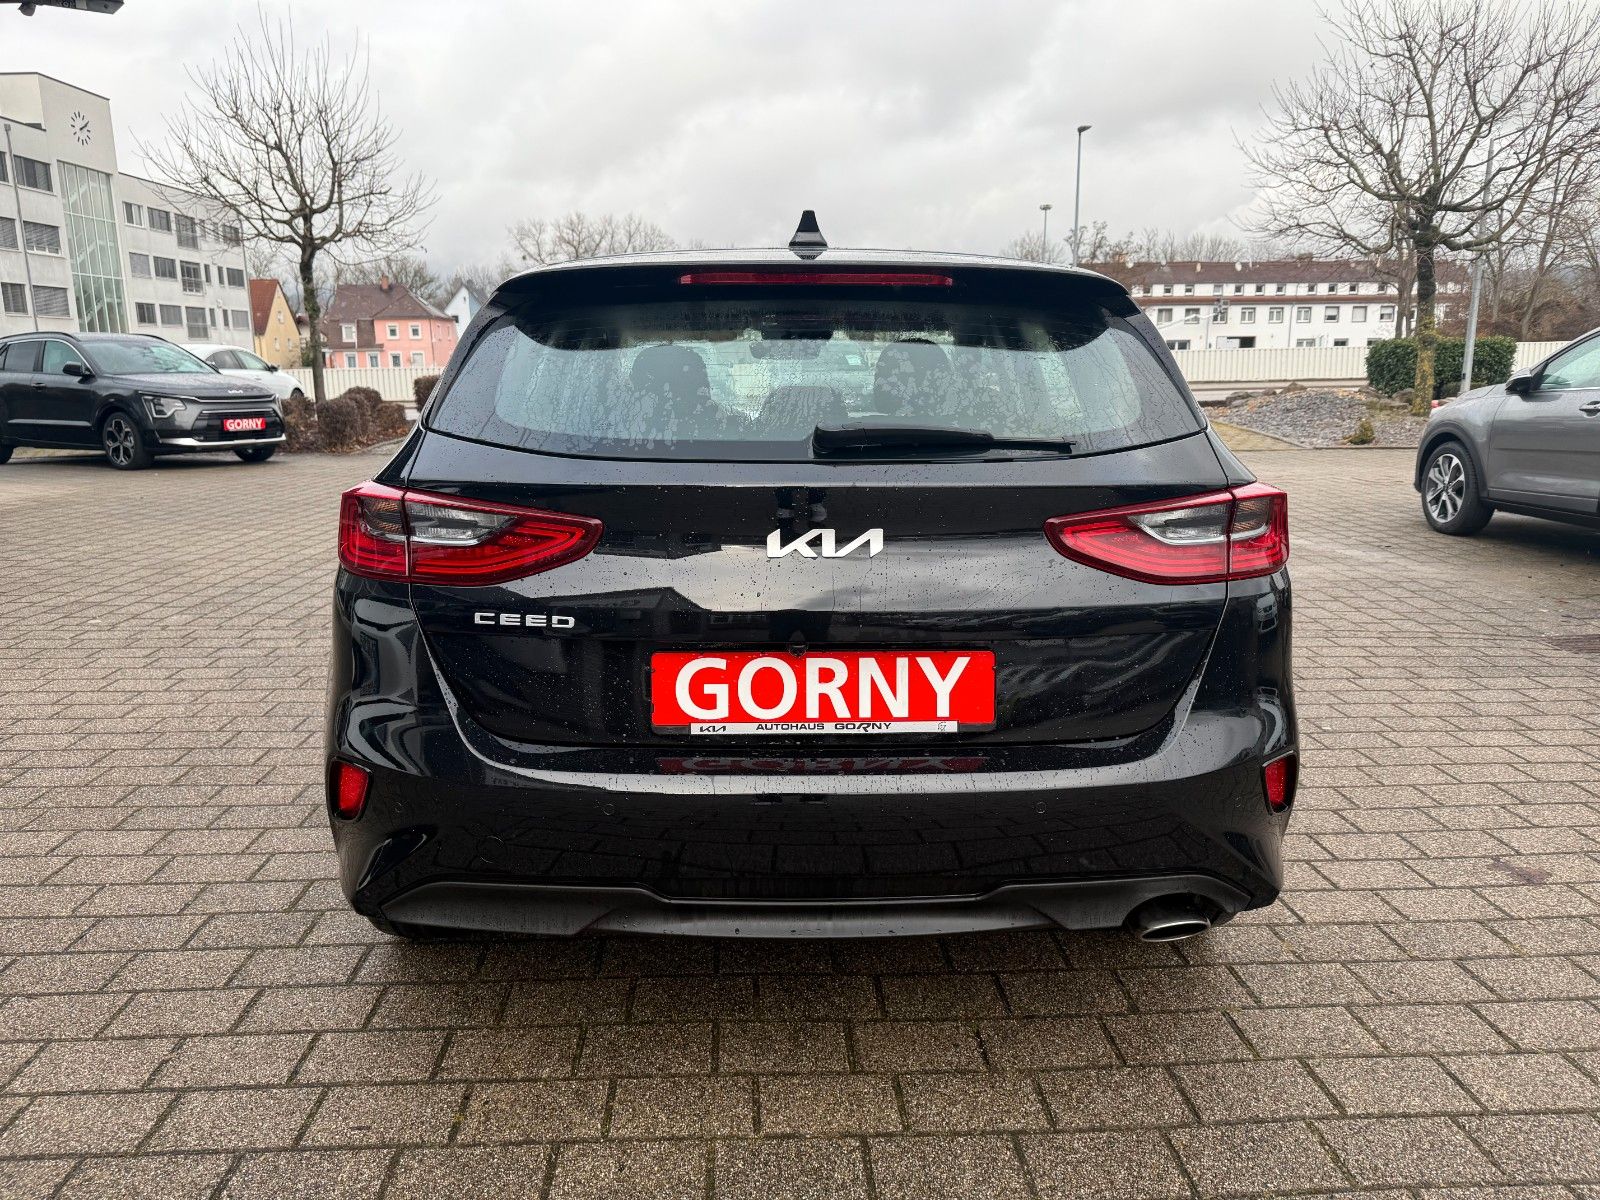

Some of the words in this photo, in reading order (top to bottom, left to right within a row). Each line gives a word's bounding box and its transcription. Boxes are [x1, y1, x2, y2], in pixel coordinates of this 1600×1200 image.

[226, 418, 263, 430] GORNY
[766, 528, 884, 558] KIA
[474, 612, 575, 628] CEED
[674, 656, 971, 720] GORNY
[756, 723, 825, 731] AUTOHAUS
[835, 722, 892, 733] GORNY
